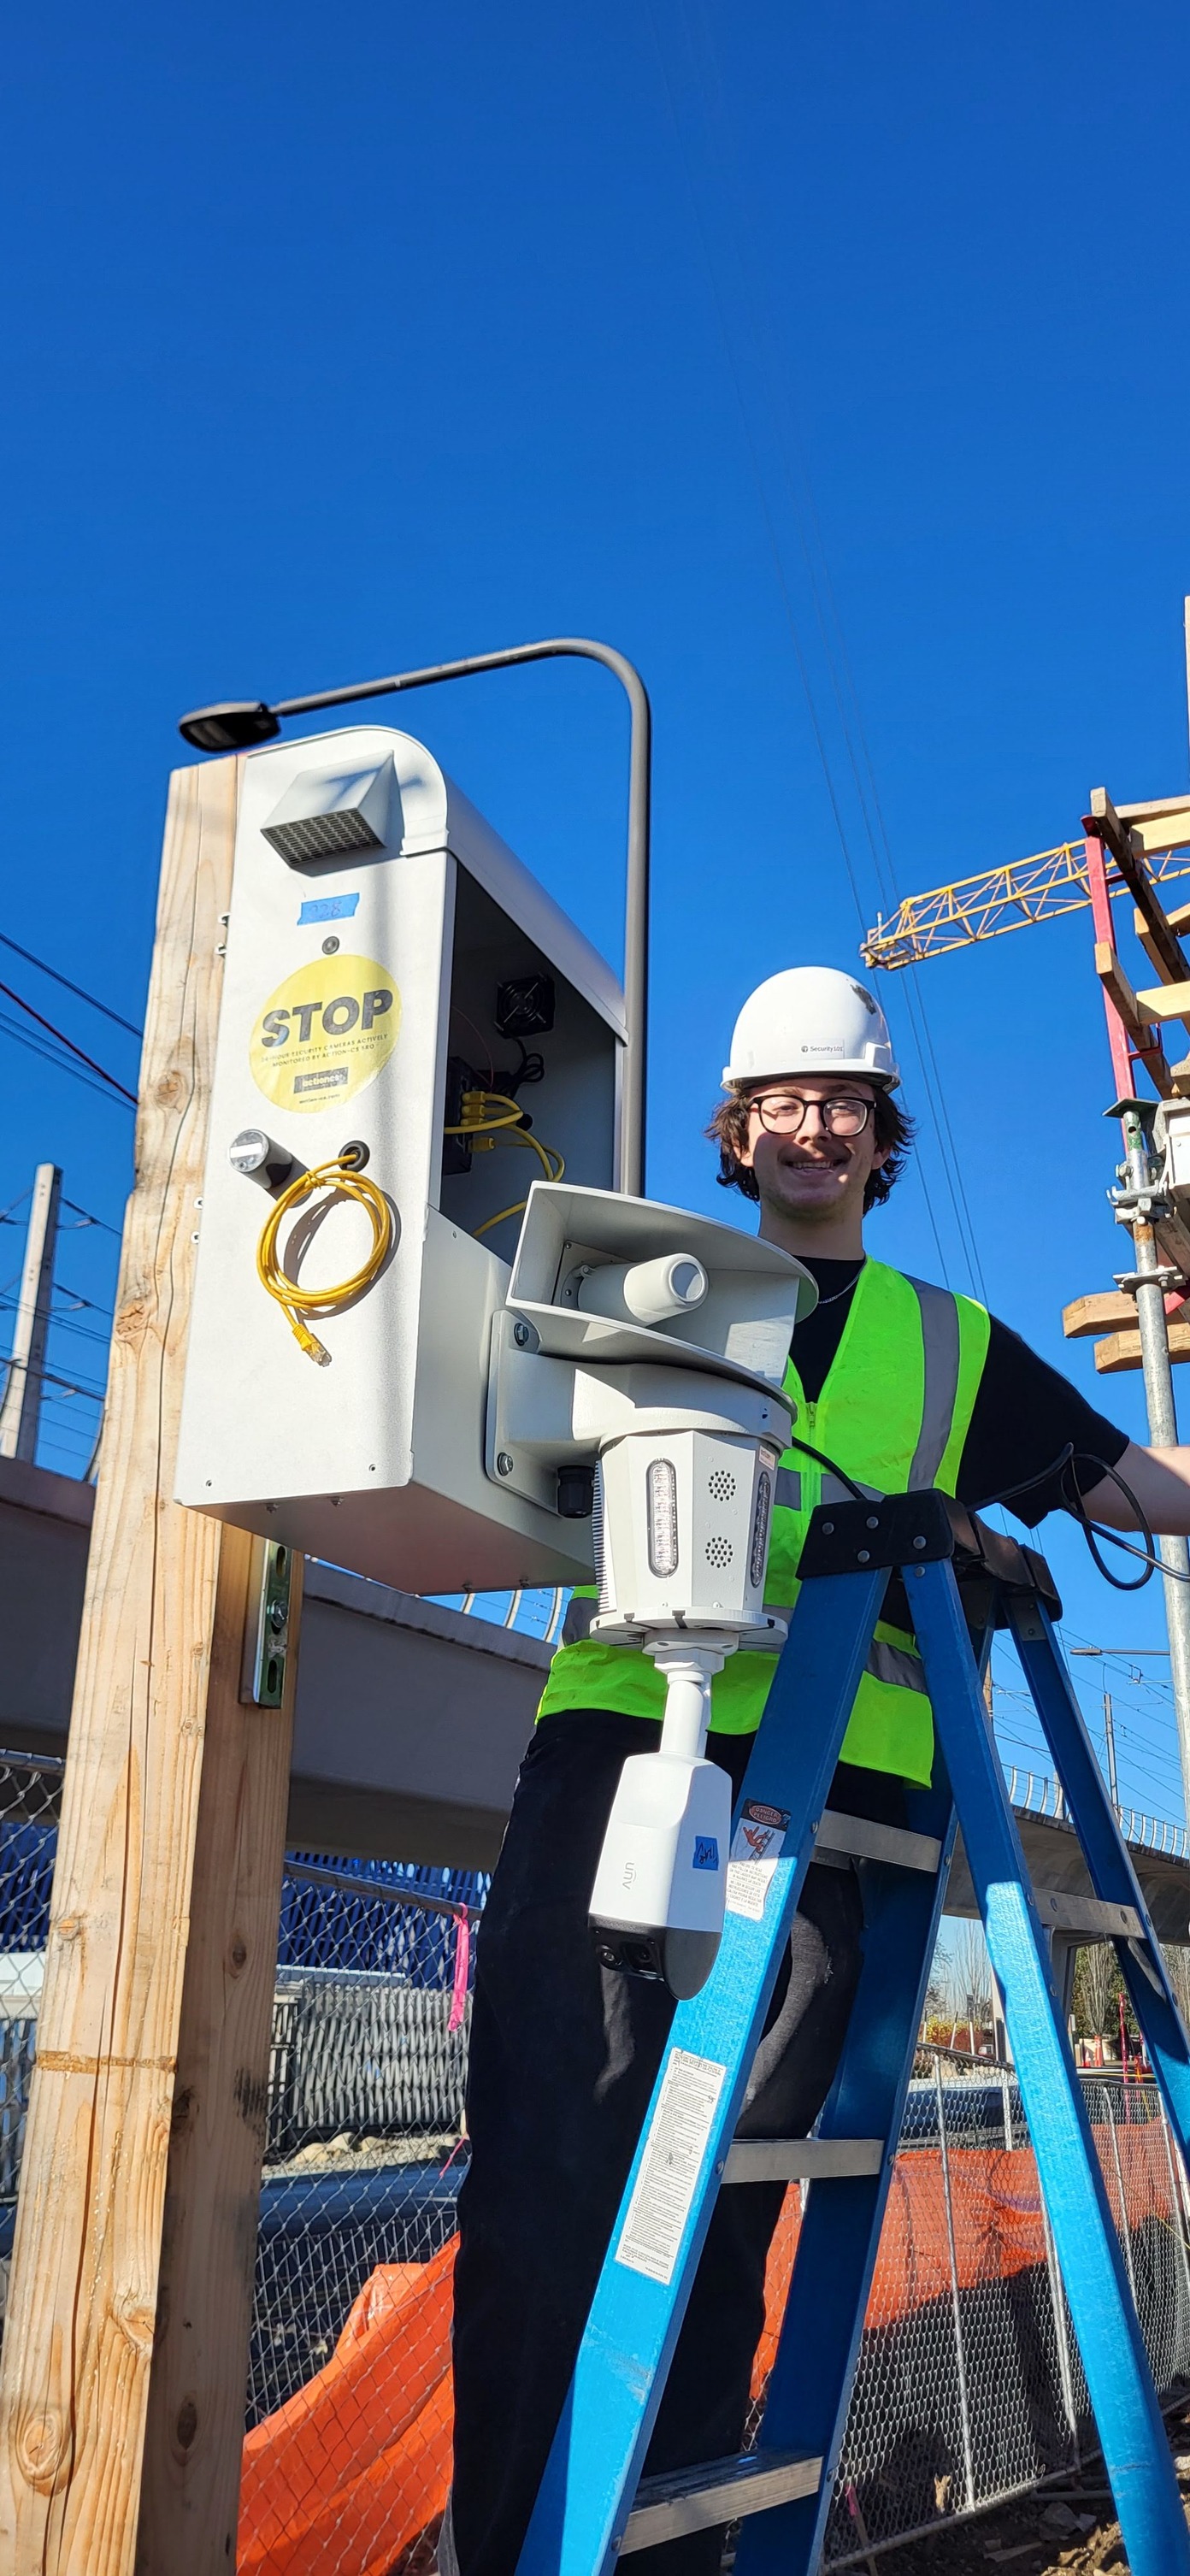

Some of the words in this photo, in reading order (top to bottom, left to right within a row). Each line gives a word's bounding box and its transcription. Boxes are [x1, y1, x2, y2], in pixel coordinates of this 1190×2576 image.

[262, 989, 393, 1048] STOP
[324, 1040, 356, 1051] CAMERAS
[356, 1034, 389, 1044] ACTIVELY
[273, 1056, 310, 1067] MONITORED
[755, 1807, 779, 1817] DANGER
[753, 1813, 777, 1823] PELIGRO
